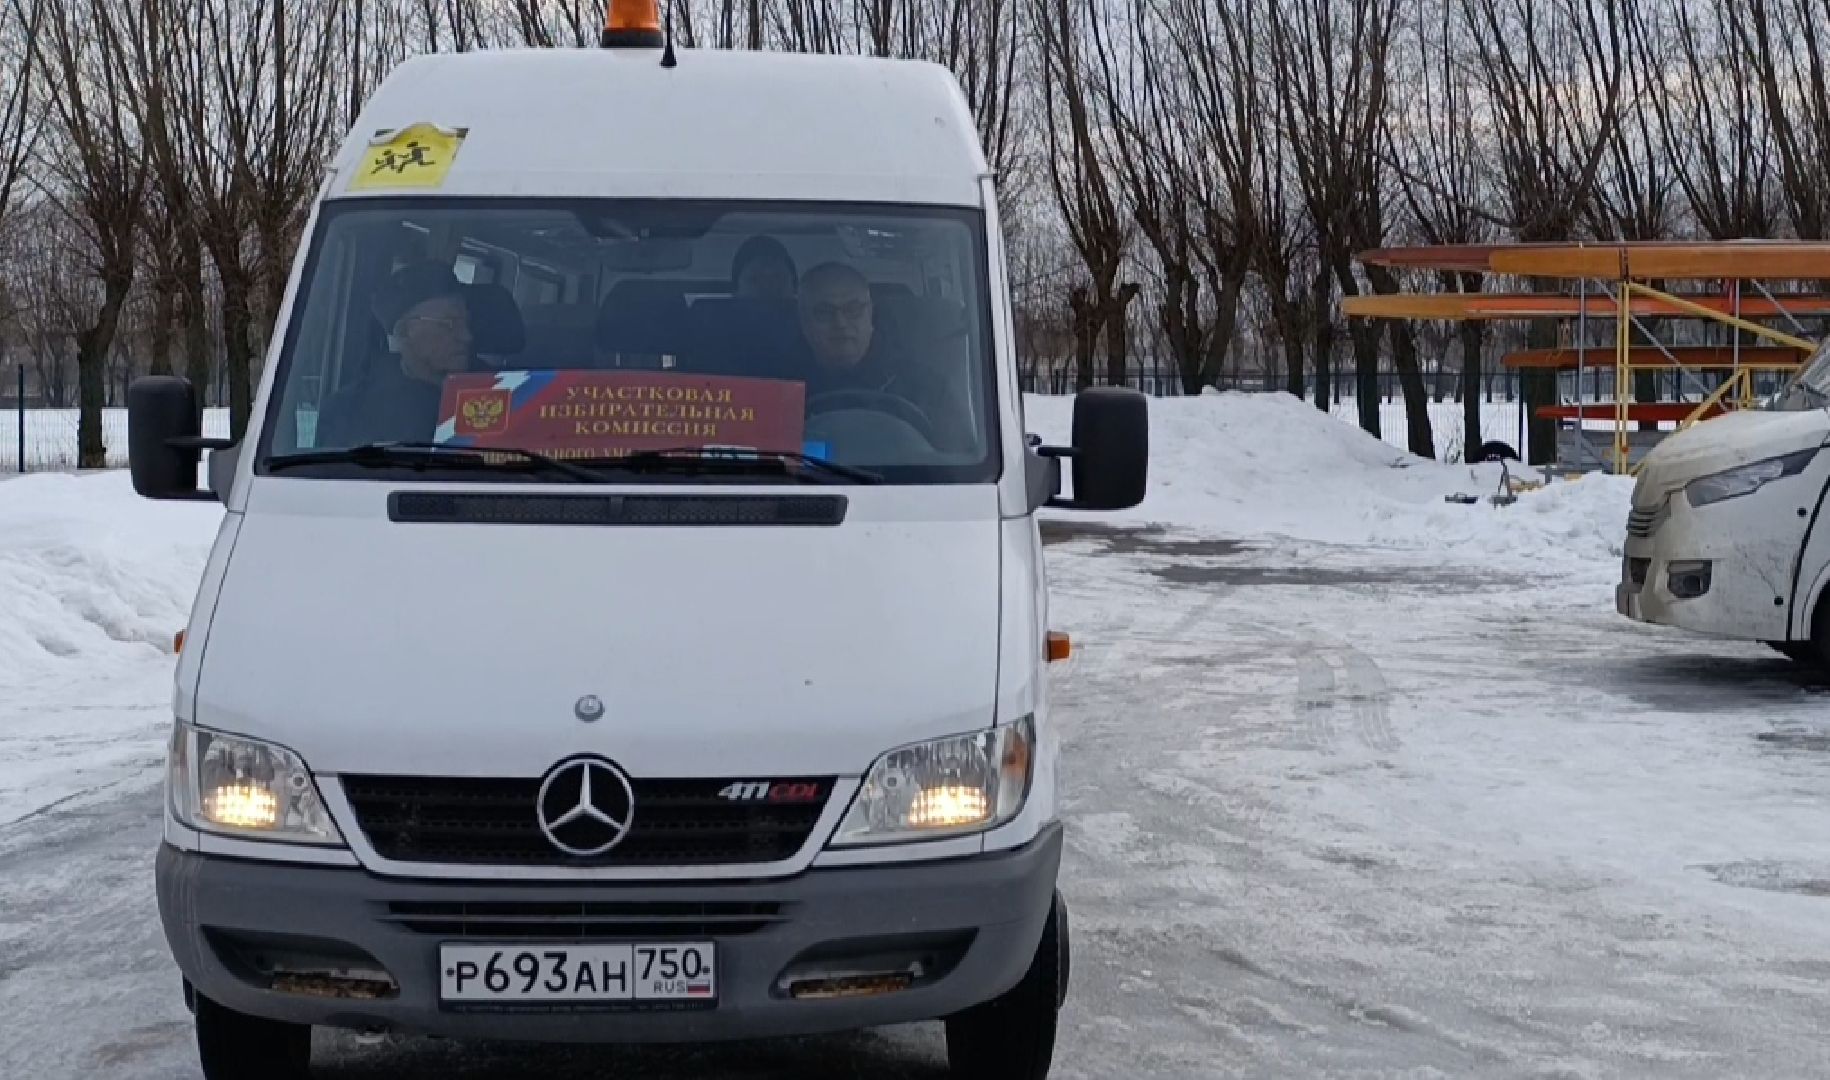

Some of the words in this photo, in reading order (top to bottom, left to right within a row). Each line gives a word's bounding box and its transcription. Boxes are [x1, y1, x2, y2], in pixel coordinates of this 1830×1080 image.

[566, 386, 732, 403] УЧАСТКОВАЯ
[539, 403, 754, 421] ИЗБИРАТЕЛЬНАЯ
[575, 420, 716, 437] КОМИССИЯ
[637, 948, 701, 980] 750
[653, 980, 685, 993] RUS
